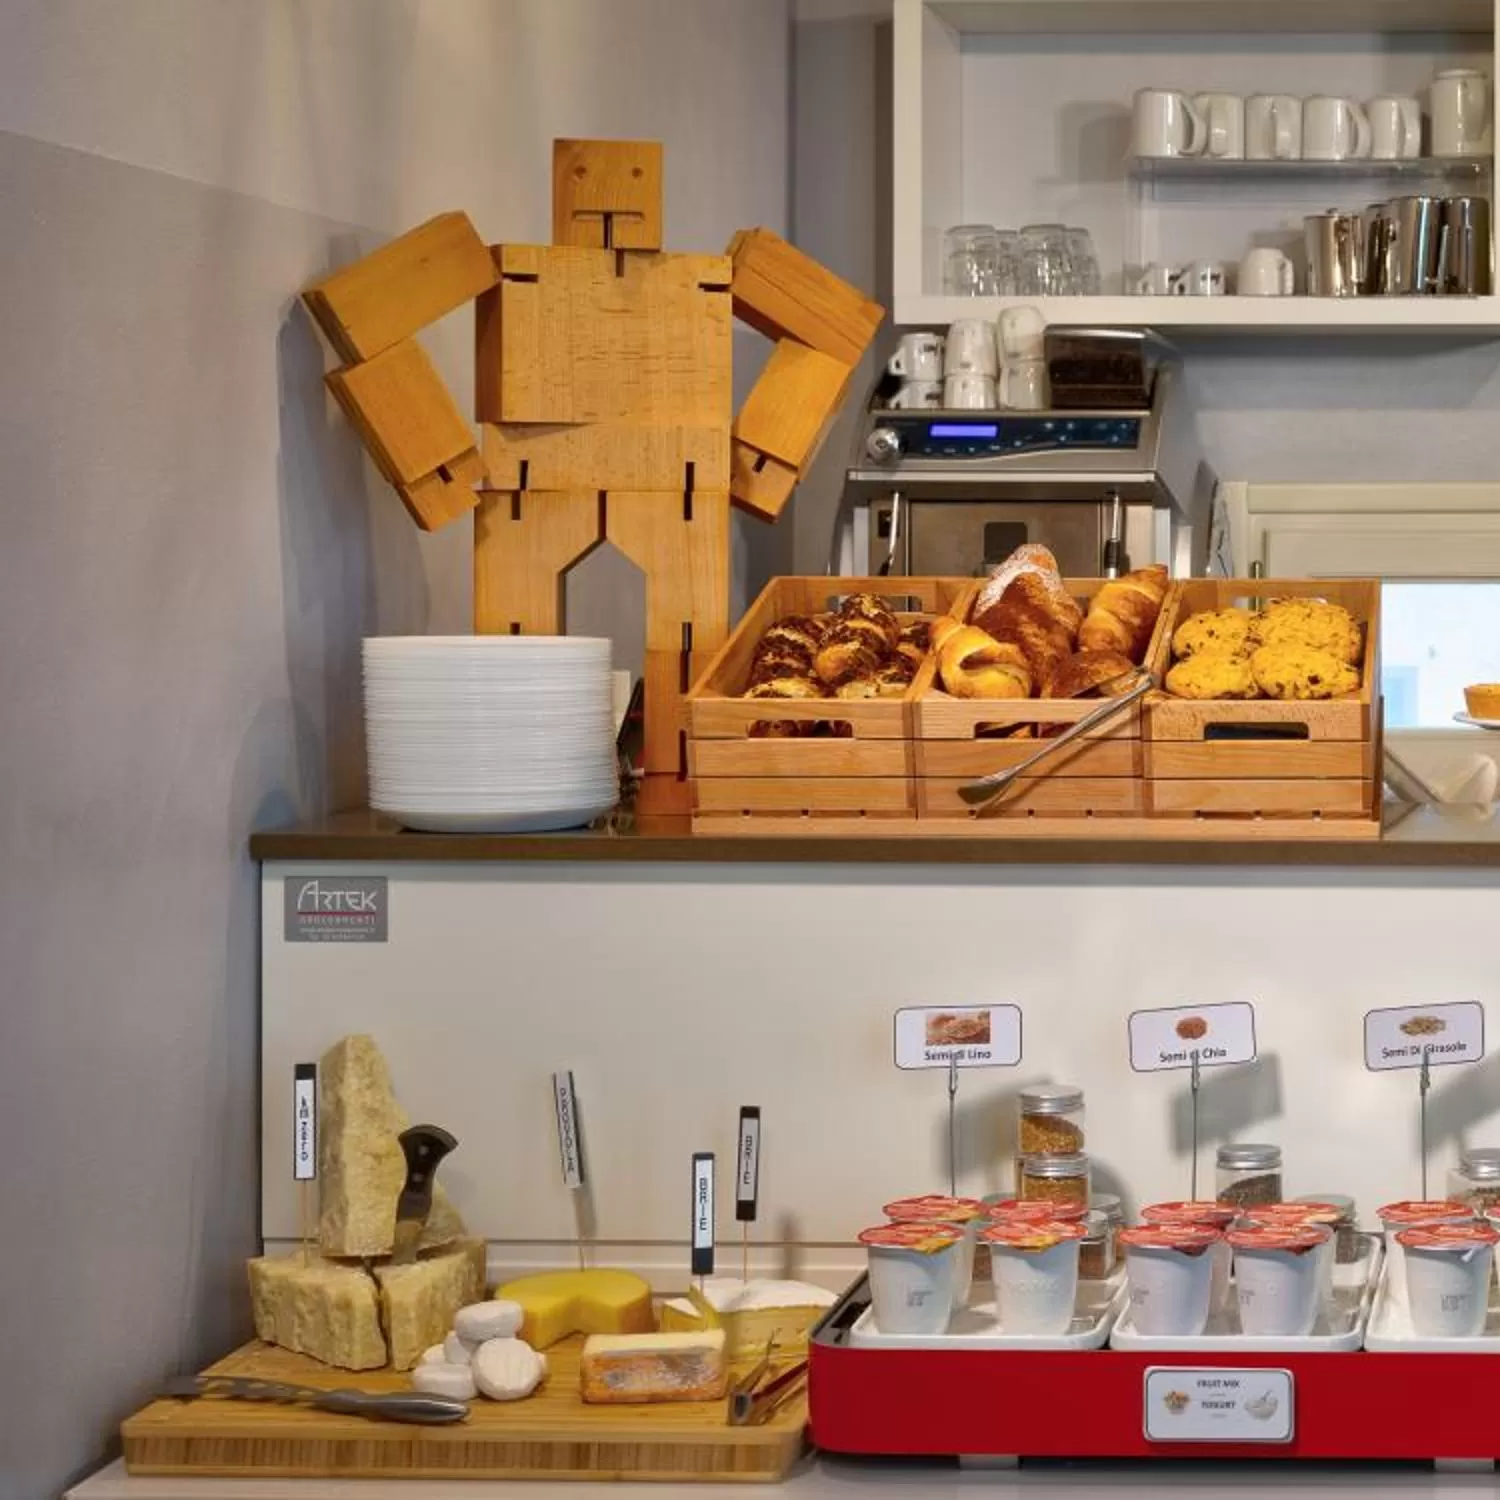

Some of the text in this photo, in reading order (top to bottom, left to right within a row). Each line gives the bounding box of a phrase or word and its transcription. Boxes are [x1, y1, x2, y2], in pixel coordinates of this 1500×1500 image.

[1202, 1047, 1227, 1059] Chia
[743, 1135, 753, 1185] BRIE
[699, 1177, 708, 1231] BRIE
